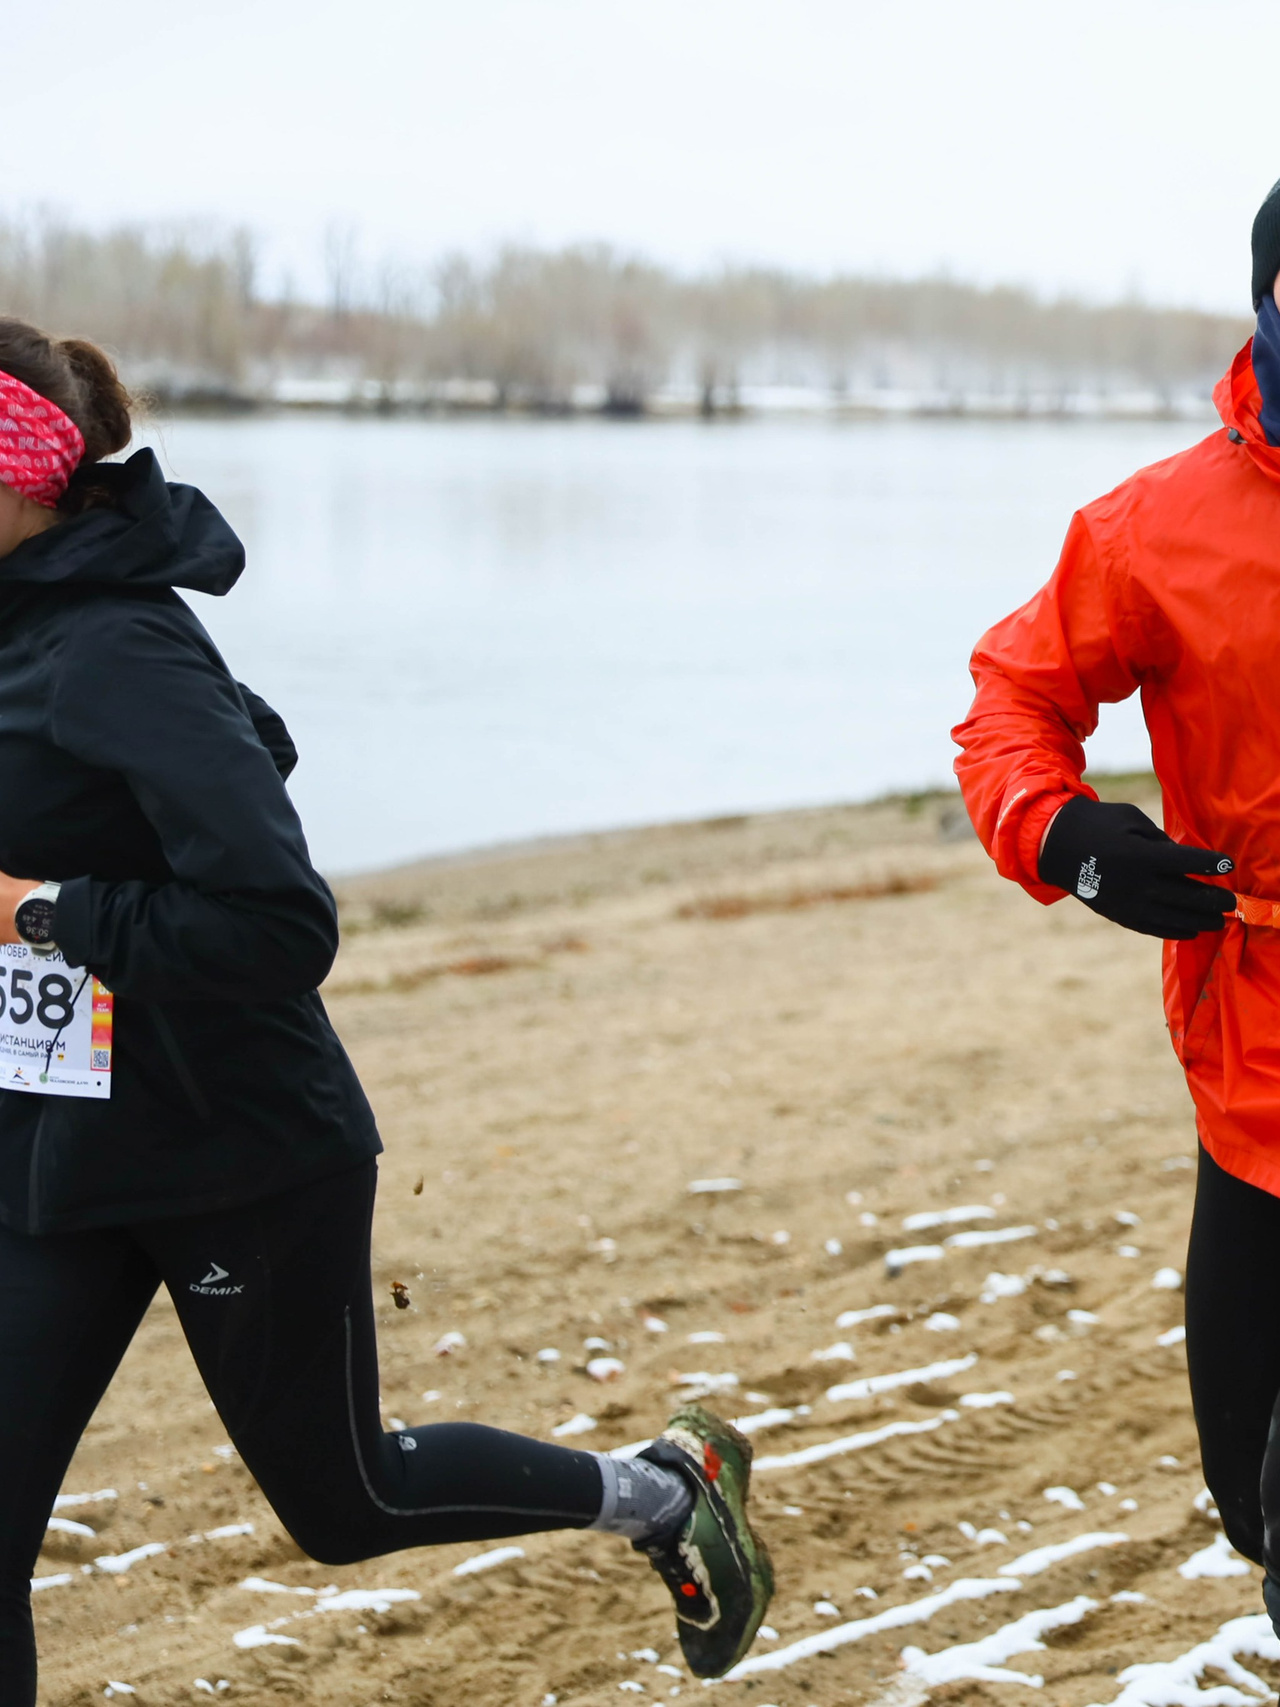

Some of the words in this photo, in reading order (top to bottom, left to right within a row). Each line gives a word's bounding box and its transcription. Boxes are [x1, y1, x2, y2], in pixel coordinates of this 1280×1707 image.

[1078, 861, 1089, 884] FACE
[1084, 855, 1097, 887] NORTH
[1091, 873, 1102, 891] THE
[0, 944, 28, 958] ТОБЕР
[0, 1033, 52, 1052] ИСТАНЦИЯ
[189, 1283, 245, 1296] DEMIX
